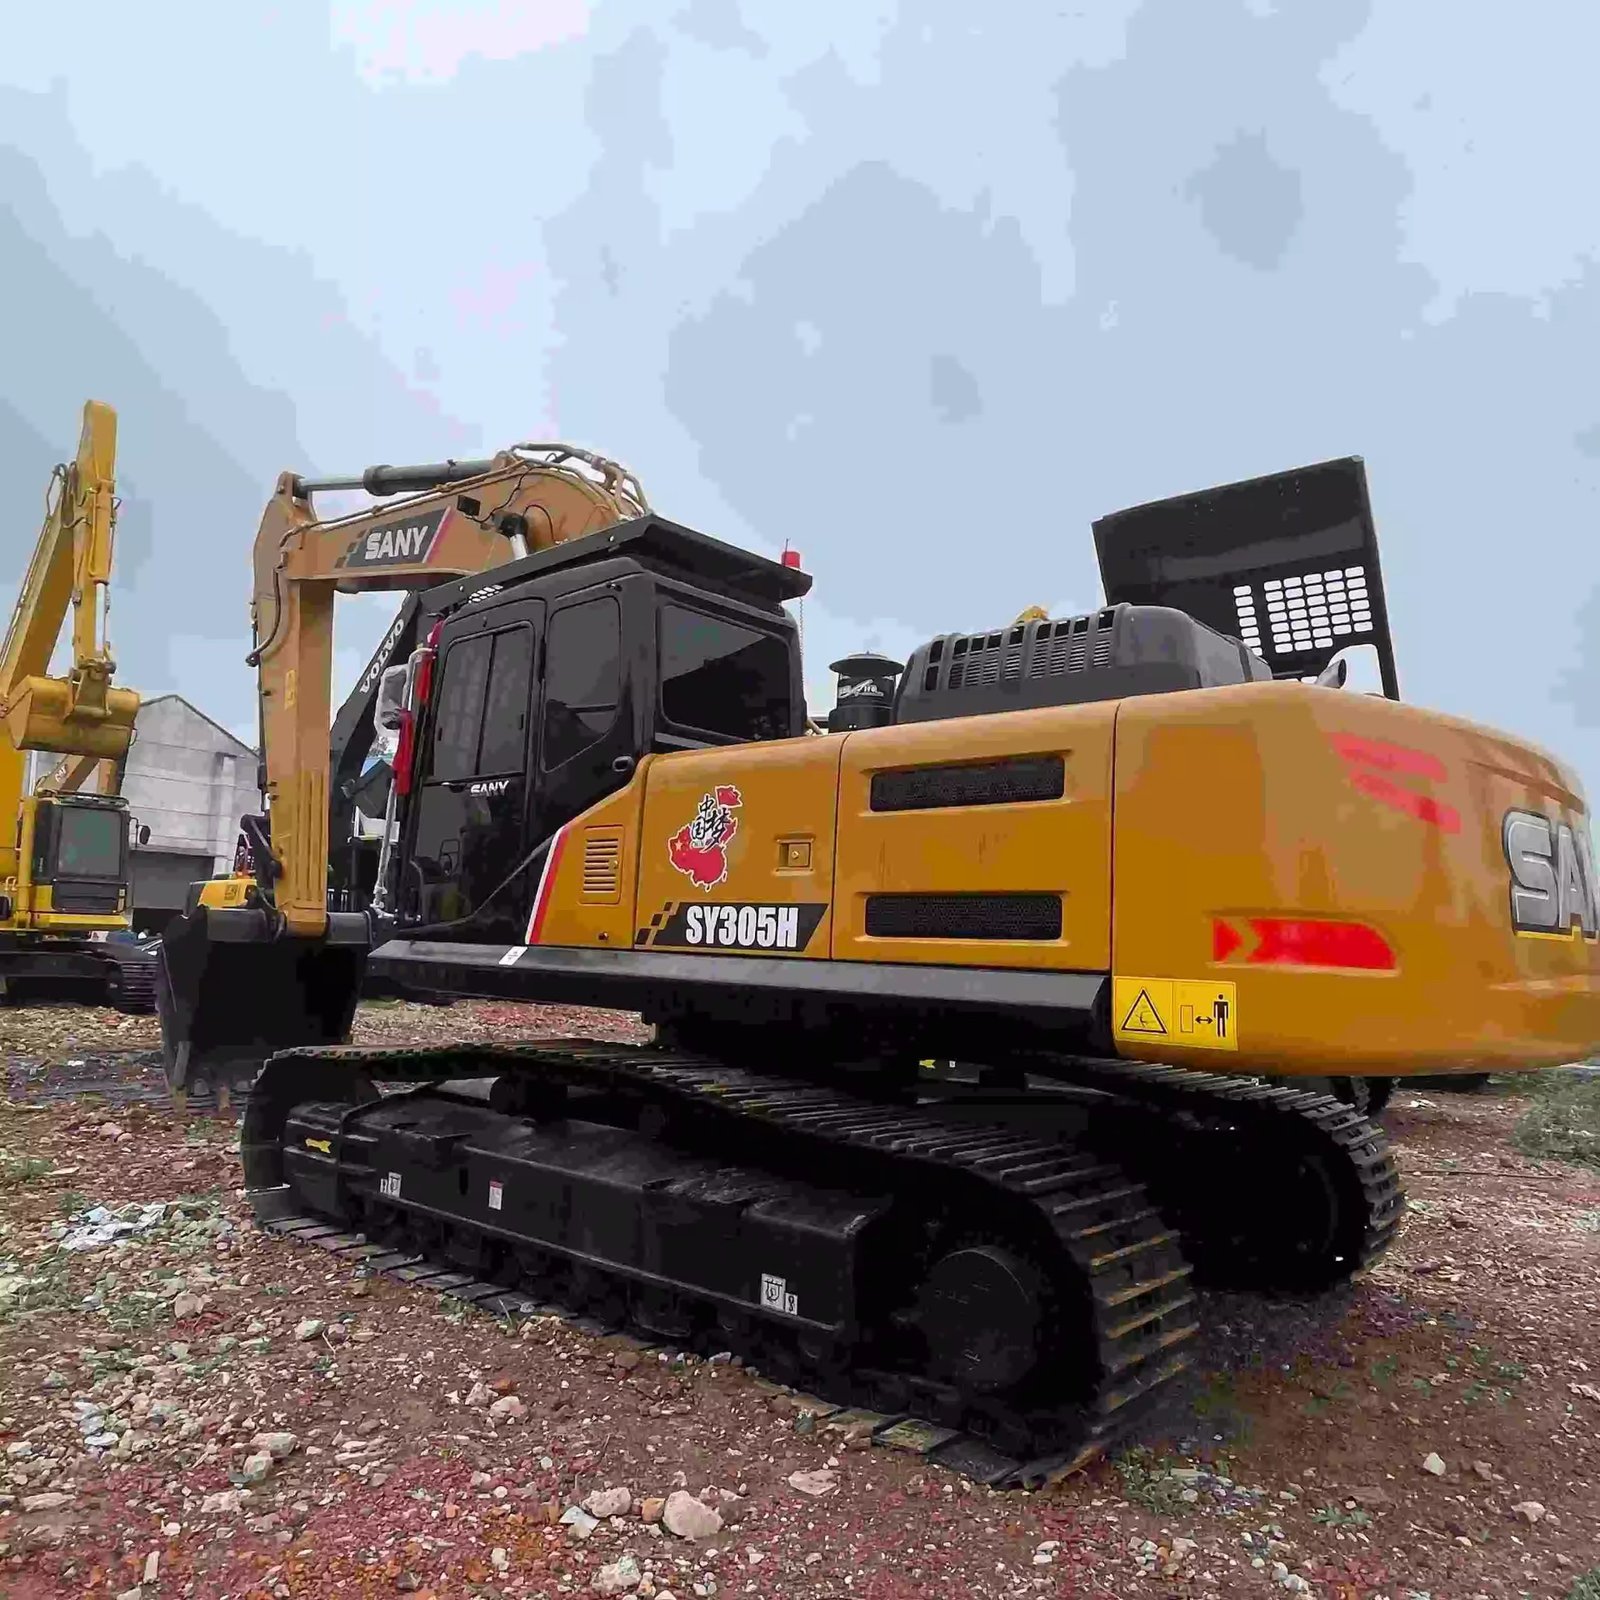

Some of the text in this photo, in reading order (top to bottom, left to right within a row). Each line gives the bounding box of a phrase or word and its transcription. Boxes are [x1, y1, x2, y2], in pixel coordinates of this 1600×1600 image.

[364, 525, 428, 560] SANY
[360, 618, 404, 693] VOLVO
[470, 780, 510, 797] SANY
[686, 905, 799, 948] SY305H
